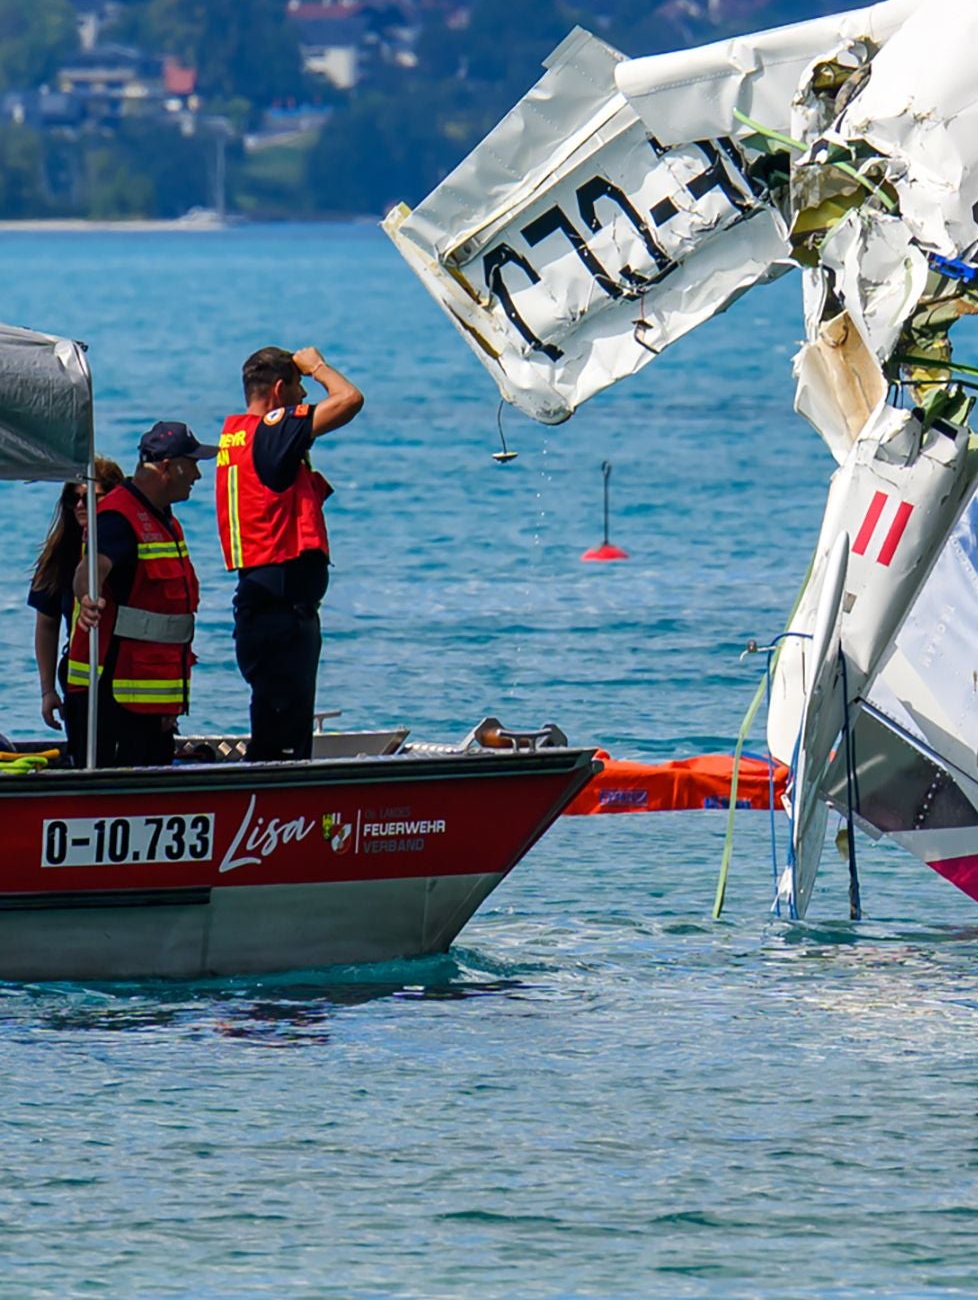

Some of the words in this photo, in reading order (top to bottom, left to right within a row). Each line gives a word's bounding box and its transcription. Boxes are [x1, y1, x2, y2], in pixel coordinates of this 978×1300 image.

[219, 794, 315, 873] Lisa
[363, 819, 446, 837] FEUERWEHR
[363, 838, 425, 854] VERBAND
